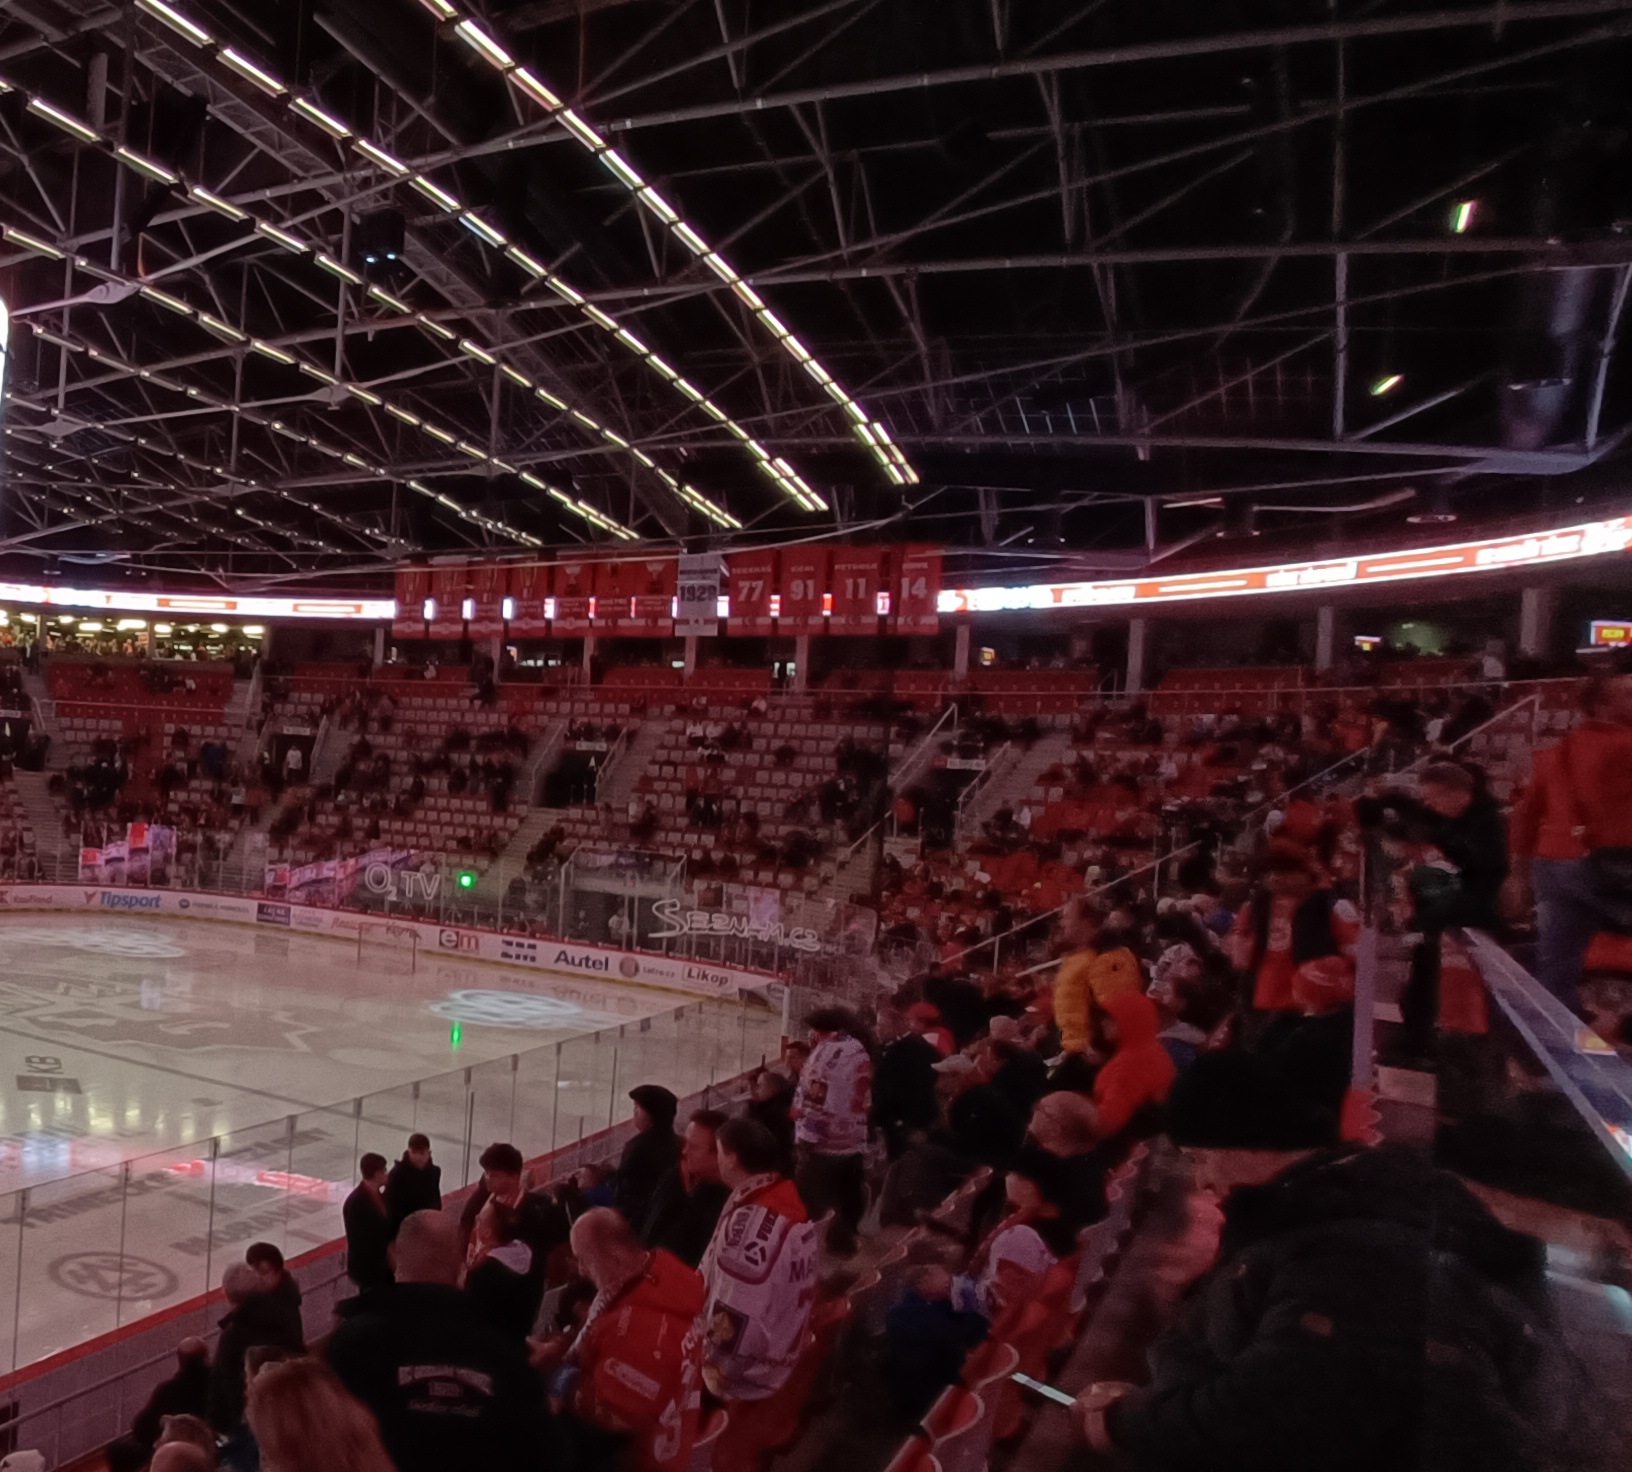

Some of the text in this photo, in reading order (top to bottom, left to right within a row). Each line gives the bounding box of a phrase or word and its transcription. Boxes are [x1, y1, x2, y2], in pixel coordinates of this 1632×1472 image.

[738, 580, 764, 601] 77
[790, 579, 814, 600] 91
[845, 578, 866, 599] 11
[901, 577, 927, 599] 14
[401, 871, 440, 900] TV
[99, 890, 161, 909] Tipsport
[554, 950, 610, 971] Autel
[687, 967, 729, 987] Likop
